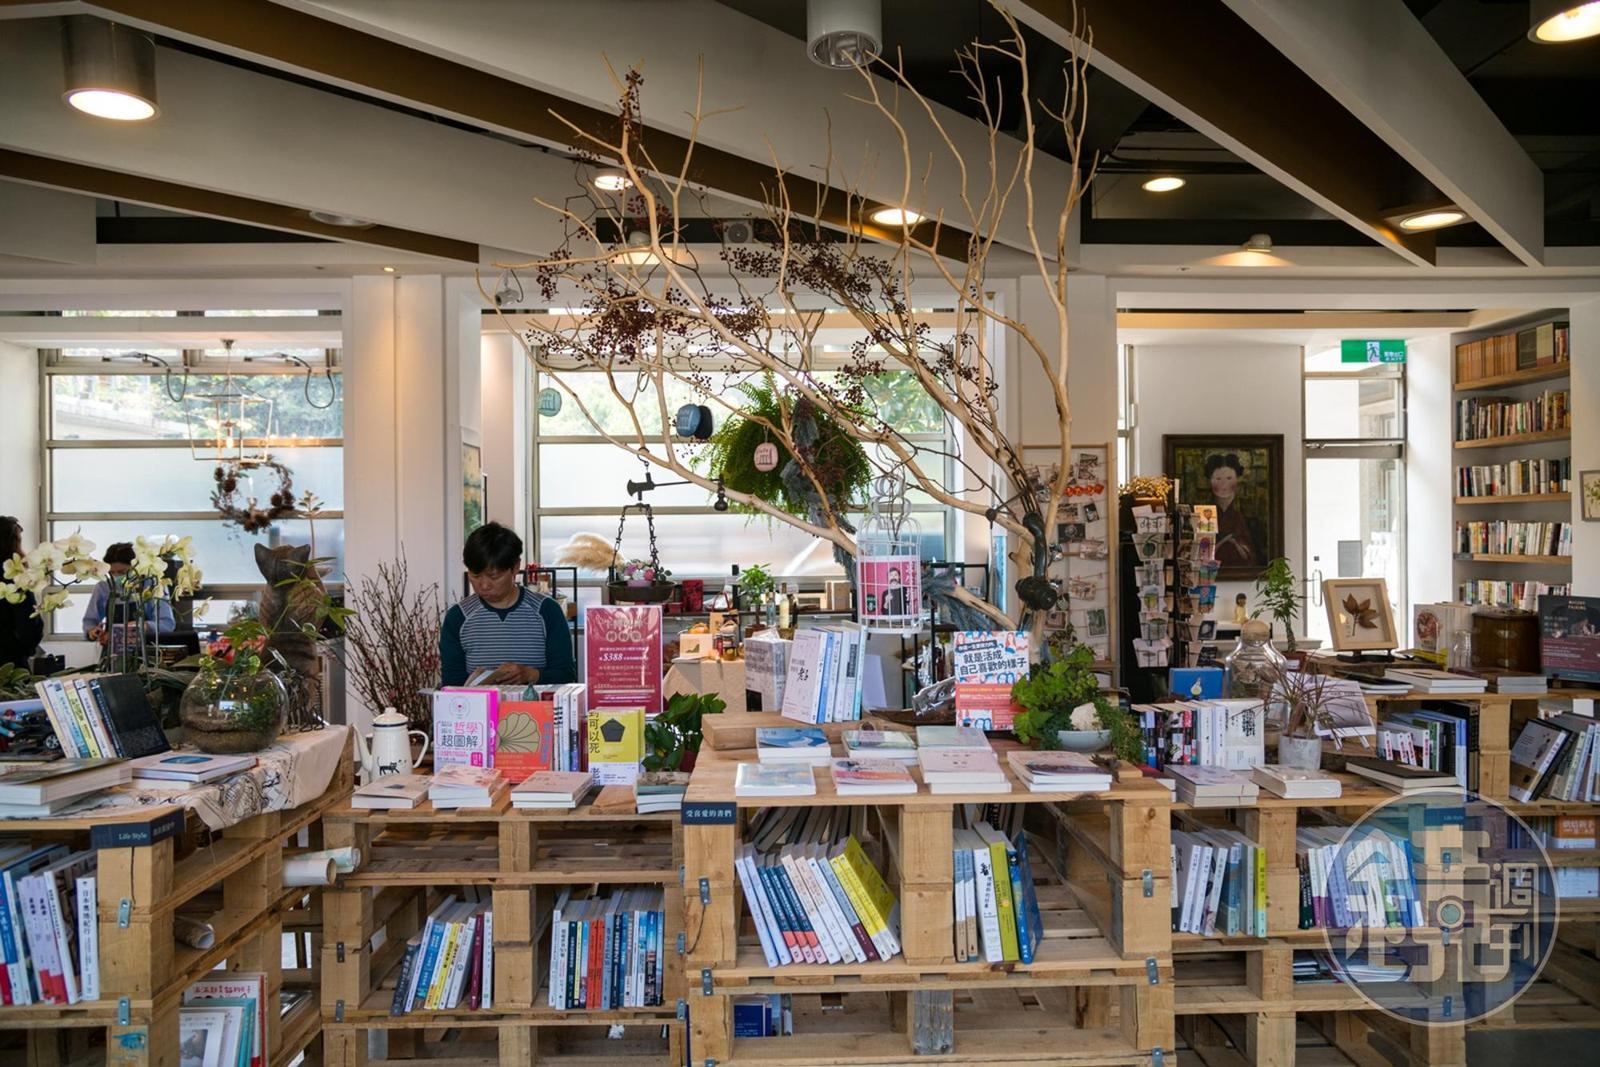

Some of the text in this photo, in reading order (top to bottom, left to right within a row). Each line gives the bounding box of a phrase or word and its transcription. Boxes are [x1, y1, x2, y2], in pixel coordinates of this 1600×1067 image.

[963, 650, 1003, 664] 就是活成
[960, 657, 1026, 675] 自己喜歡的樣子
[454, 721, 478, 735] 哲學
[441, 735, 478, 748] 超圖解
[686, 809, 732, 818] 受喜愛的書們
[132, 832, 147, 841] Style
